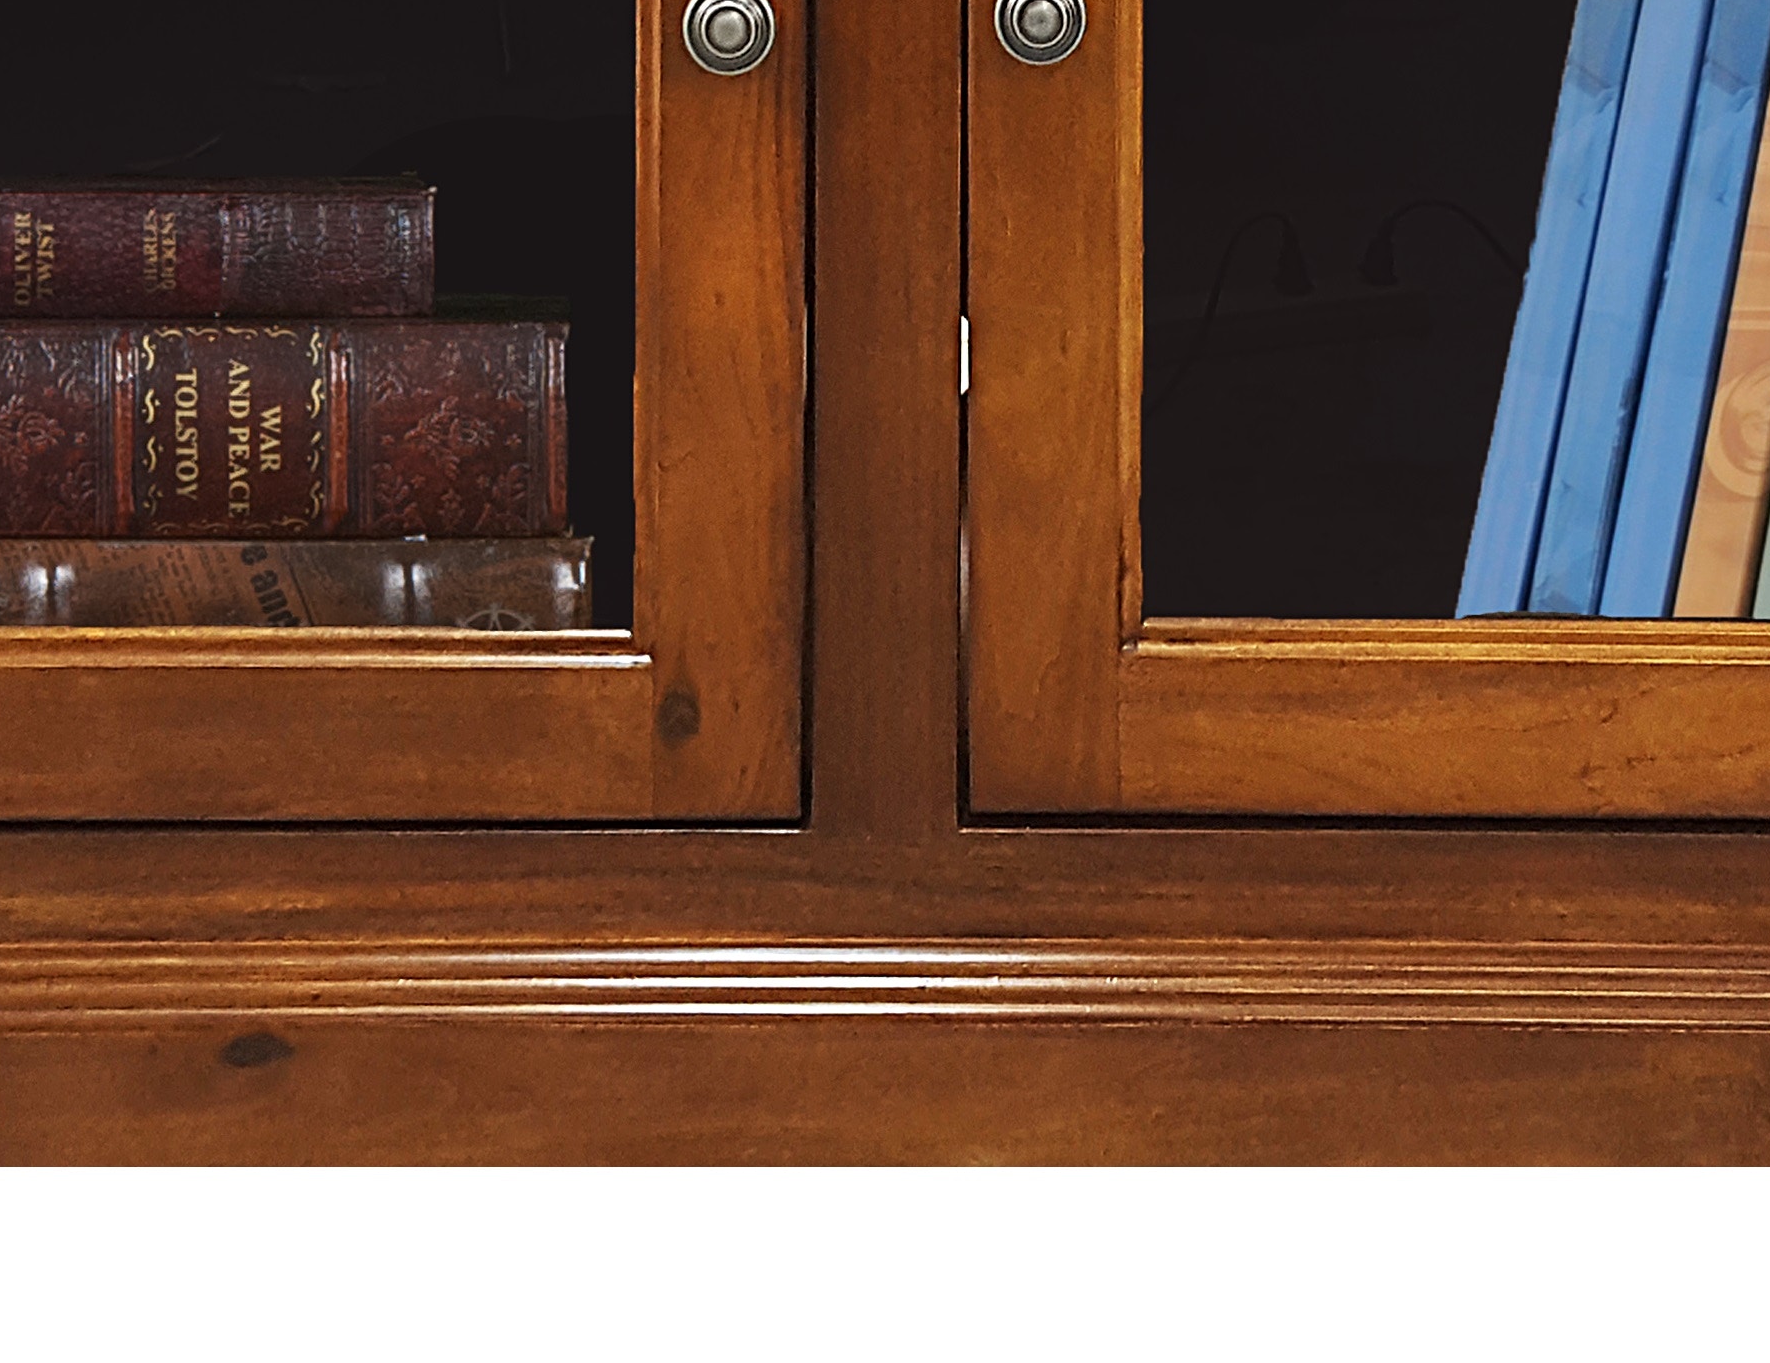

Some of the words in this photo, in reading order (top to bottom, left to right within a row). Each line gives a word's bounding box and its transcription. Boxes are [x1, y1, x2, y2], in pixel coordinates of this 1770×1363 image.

[14, 212, 32, 306] OLIVER
[36, 218, 55, 298] TWIST
[227, 358, 251, 419] AND
[174, 367, 200, 501] TOLSTOY
[227, 426, 251, 519] PEACE
[259, 405, 282, 473] WAR
